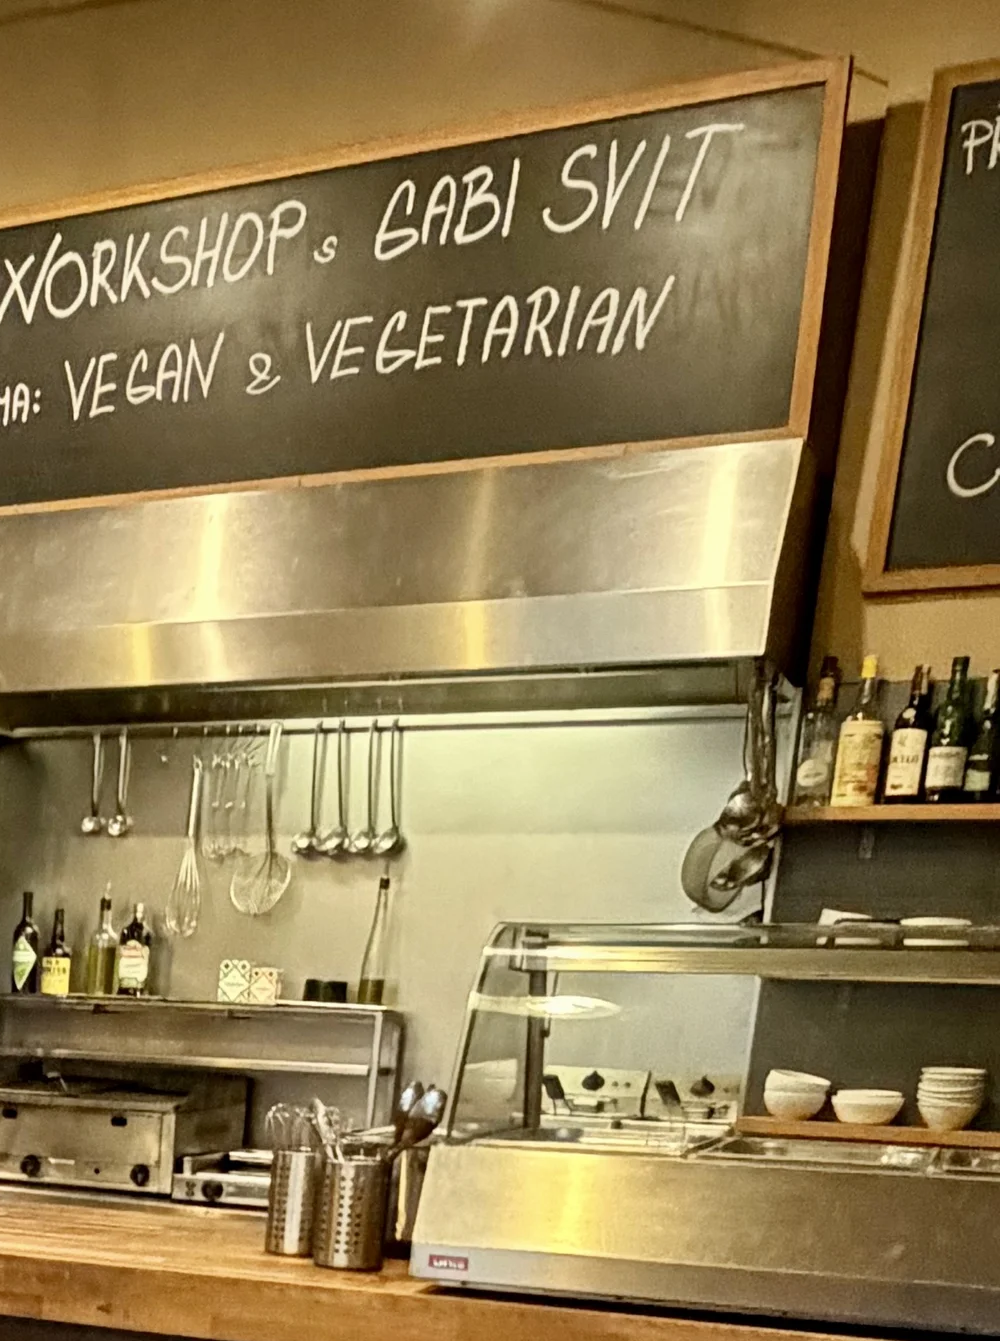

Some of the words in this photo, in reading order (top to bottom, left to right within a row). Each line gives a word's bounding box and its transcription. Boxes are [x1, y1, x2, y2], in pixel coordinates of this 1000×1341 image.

[373, 156, 521, 261] GABI
[541, 122, 745, 234] SVIT
[63, 330, 225, 422] VEGAN
[244, 352, 281, 396] &
[304, 275, 676, 383] VEGETARIAN
